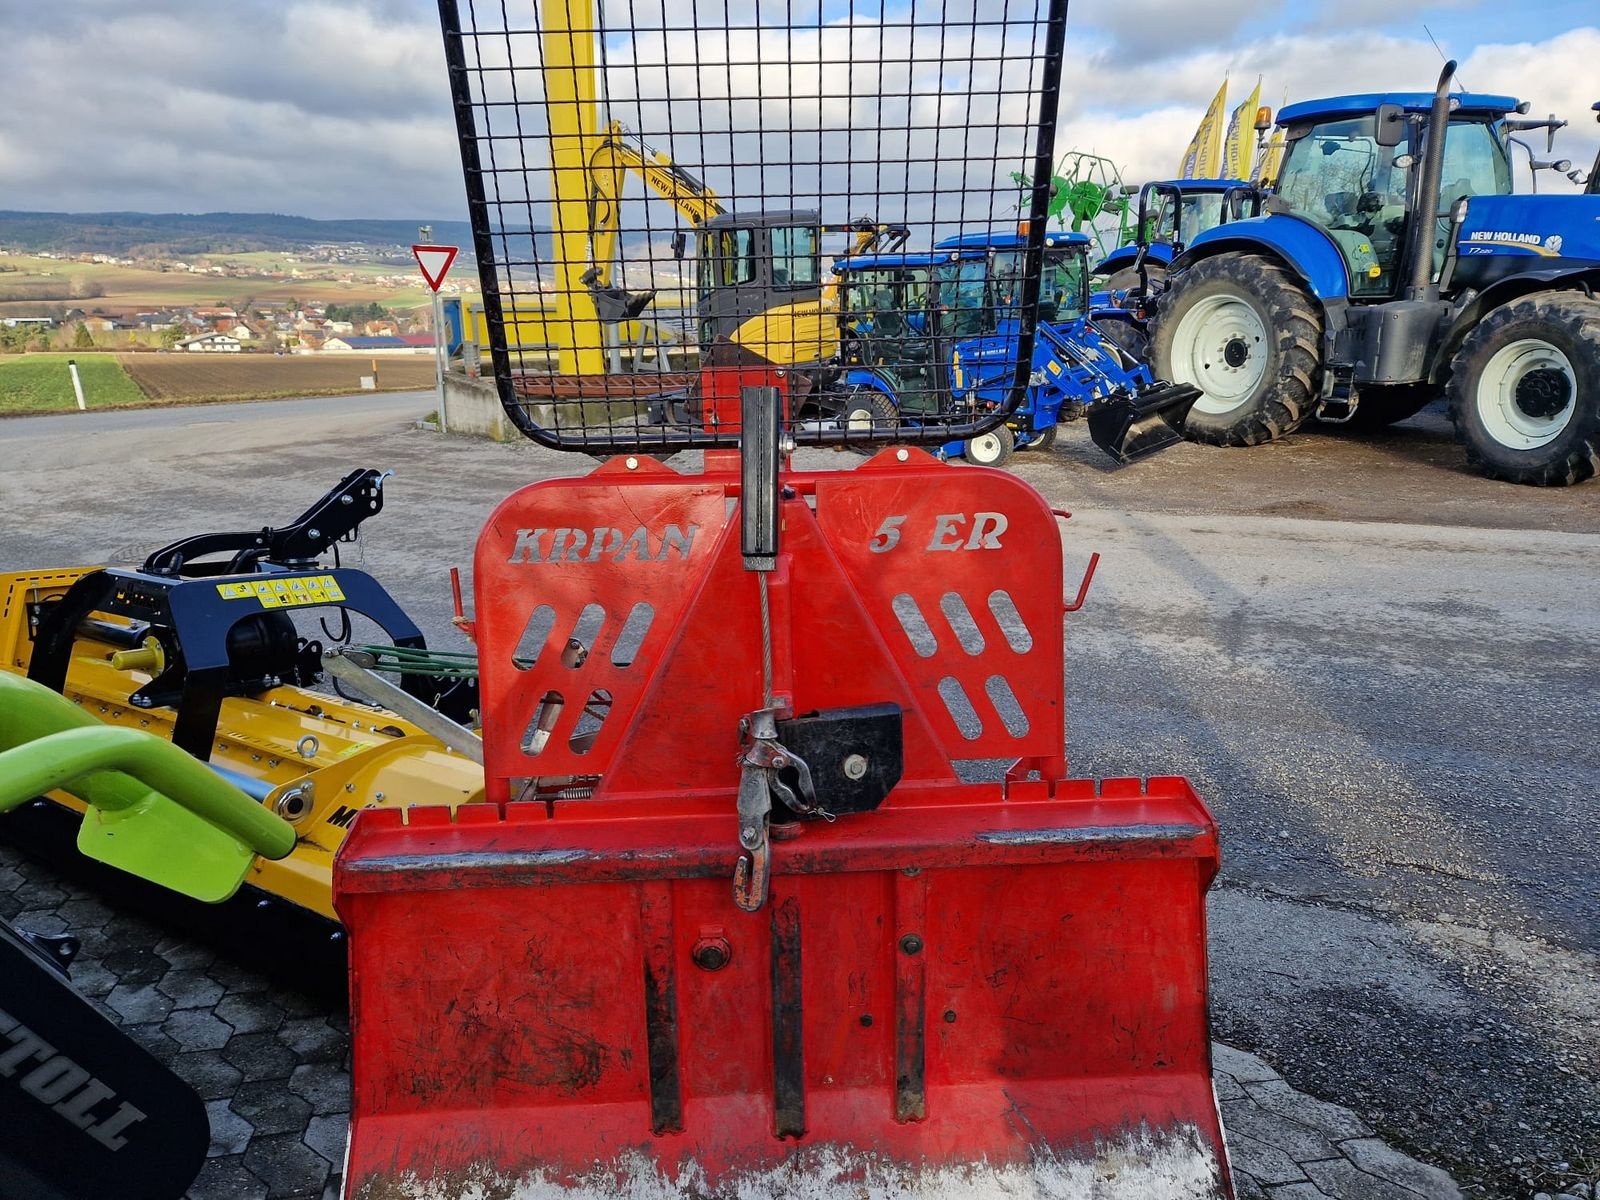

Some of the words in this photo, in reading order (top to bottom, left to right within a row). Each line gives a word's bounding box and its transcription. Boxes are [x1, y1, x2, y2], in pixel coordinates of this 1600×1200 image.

[651, 175, 669, 195] NEW
[1470, 231, 1493, 241] NEW
[1494, 231, 1541, 245] HOLLAND
[506, 524, 702, 563] KRPAN
[869, 515, 908, 553] 5
[926, 512, 1009, 551] ER
